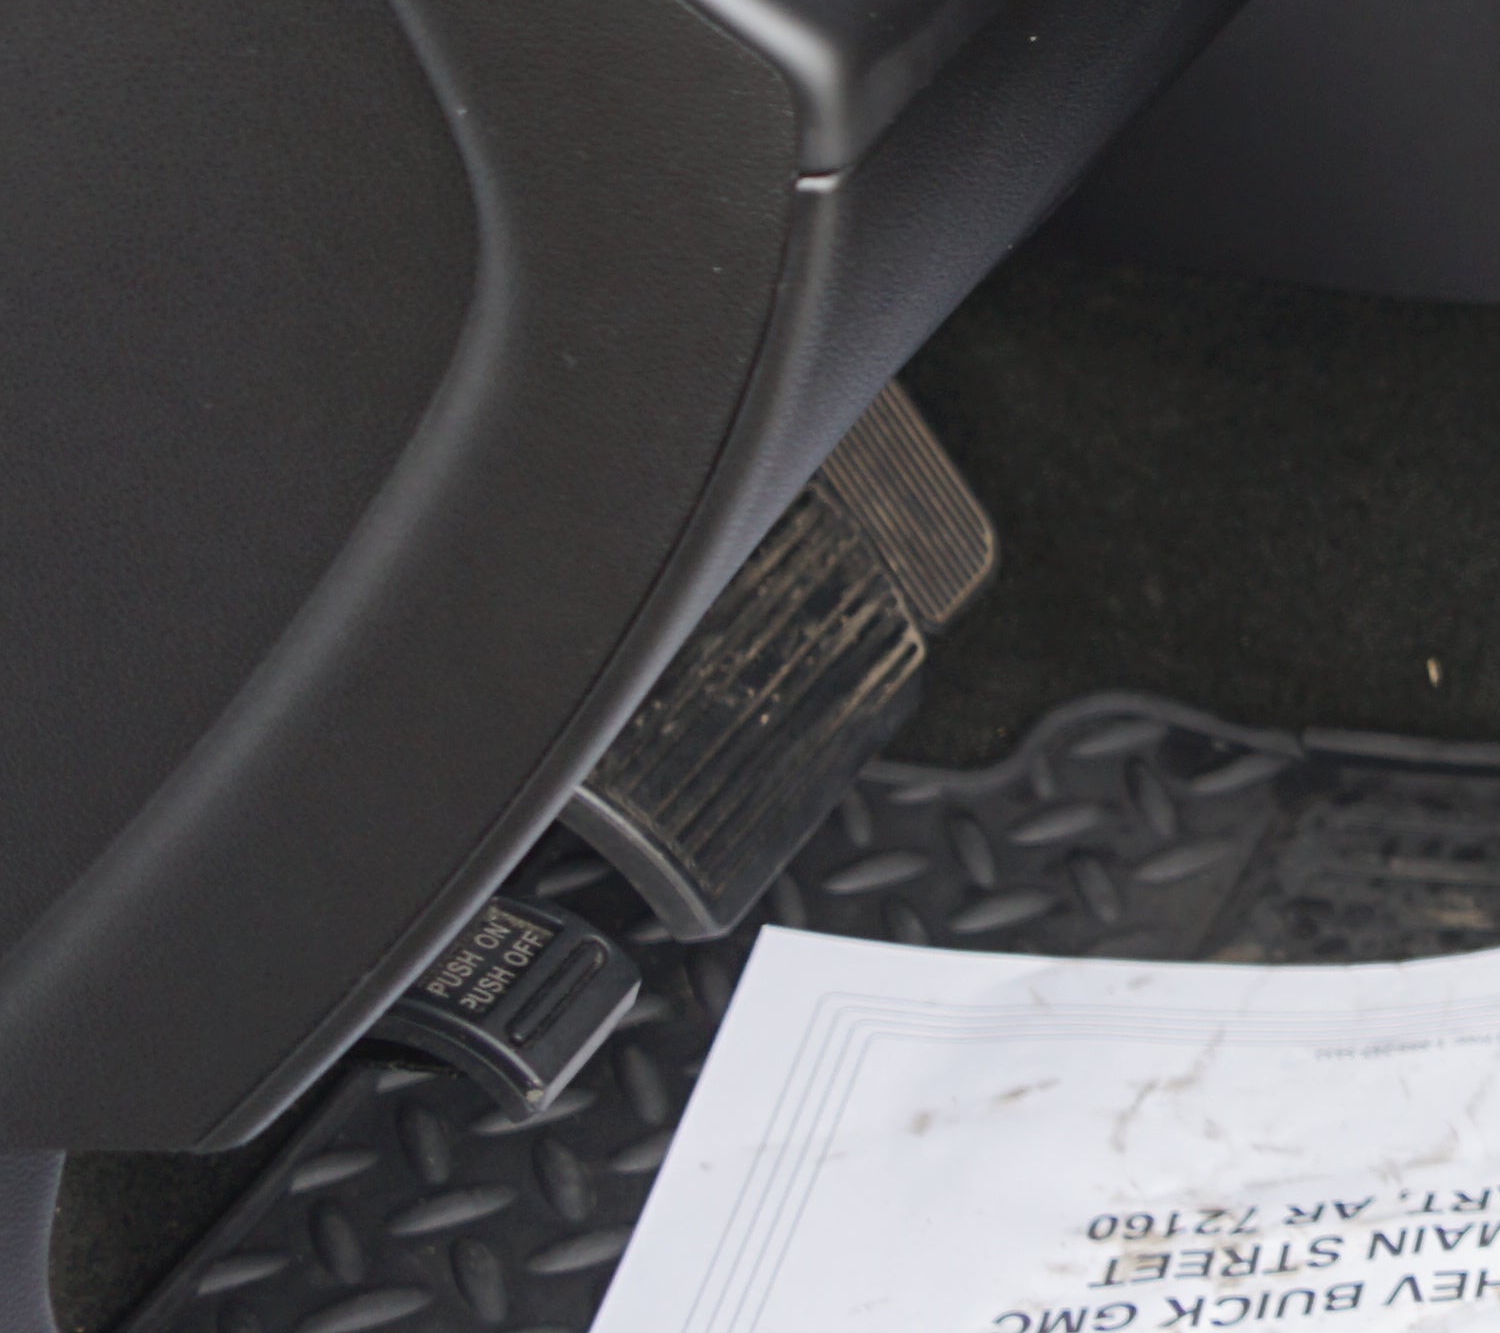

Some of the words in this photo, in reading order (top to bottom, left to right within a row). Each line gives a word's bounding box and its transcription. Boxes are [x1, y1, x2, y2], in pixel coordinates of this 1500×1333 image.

[427, 950, 484, 998] PUSH
[474, 921, 511, 949] ON
[503, 930, 543, 966] OFF
[1087, 1204, 1261, 1242] 72160
[1285, 1194, 1376, 1226] AR
[1088, 1234, 1346, 1288] STREET
[1158, 1281, 1366, 1328] BUICK
